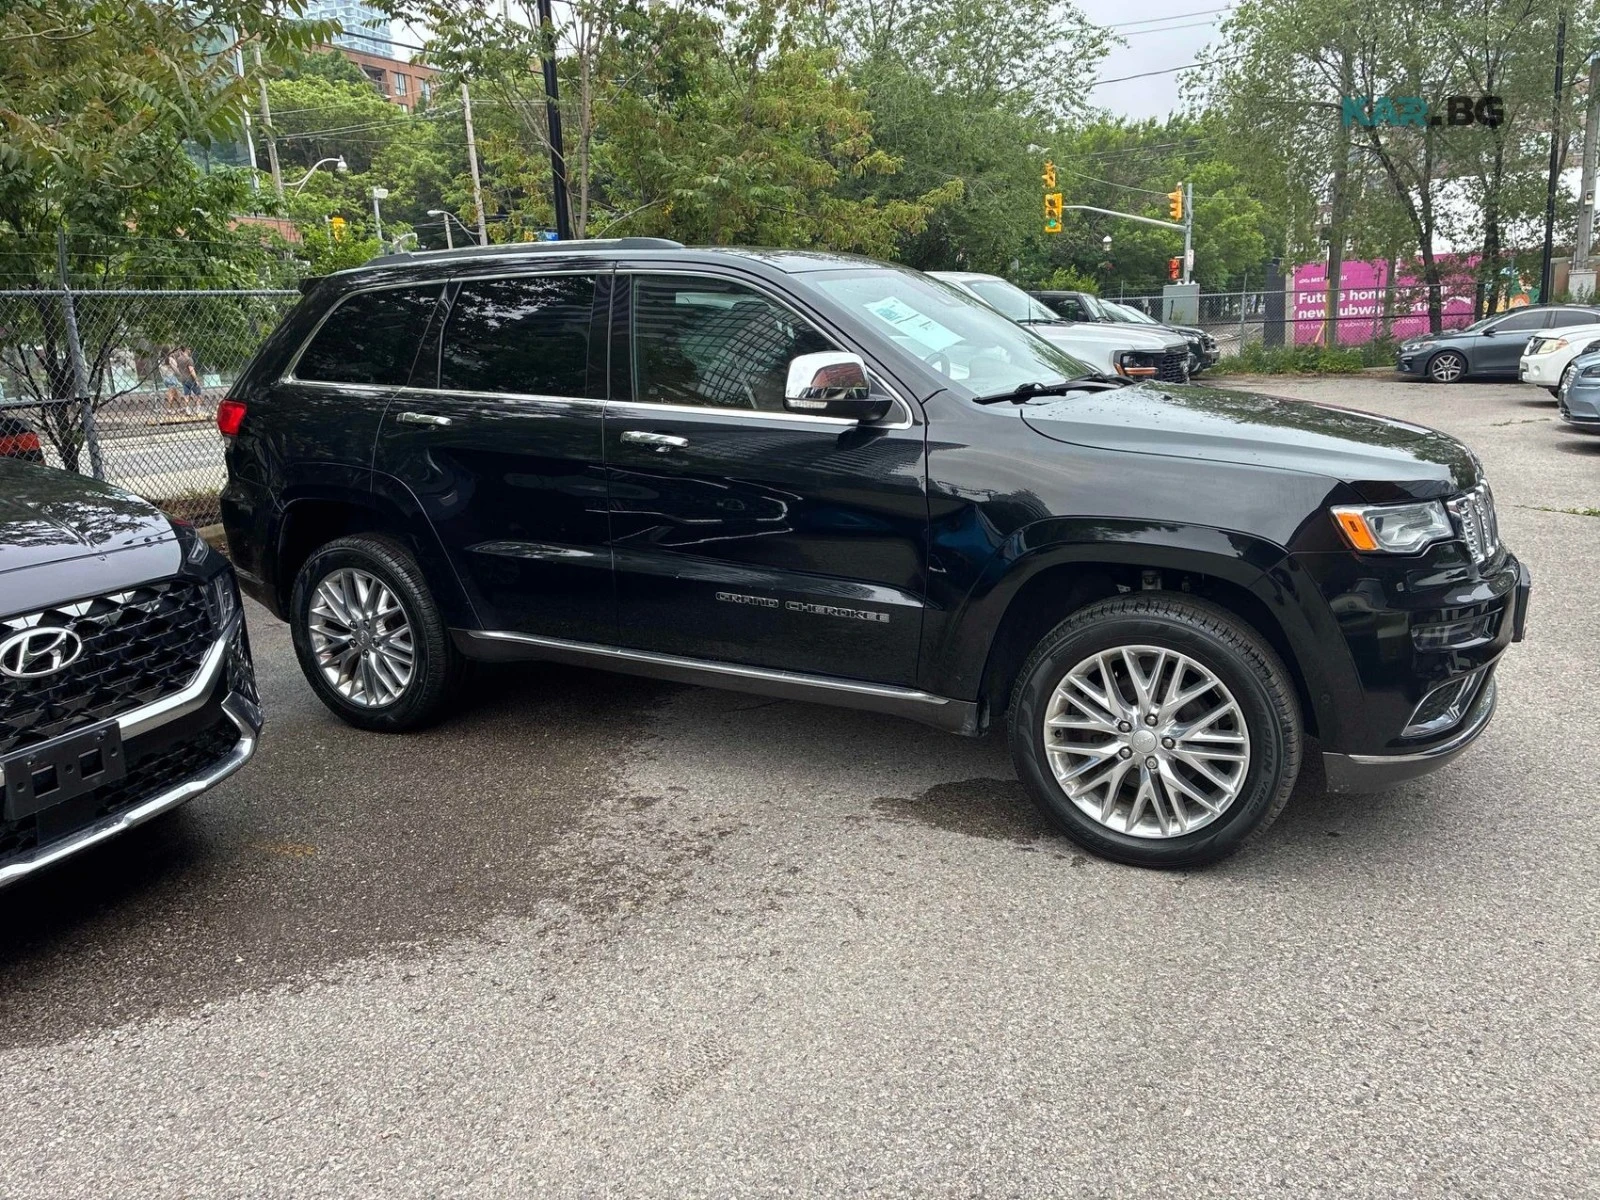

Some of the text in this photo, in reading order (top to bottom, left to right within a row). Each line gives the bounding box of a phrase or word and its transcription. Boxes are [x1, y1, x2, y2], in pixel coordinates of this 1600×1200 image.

[1299, 292, 1346, 304] Fute
[1298, 309, 1326, 319] new
[1338, 304, 1385, 317] ubwa
[715, 591, 890, 623] GRAND CHEROKEE
